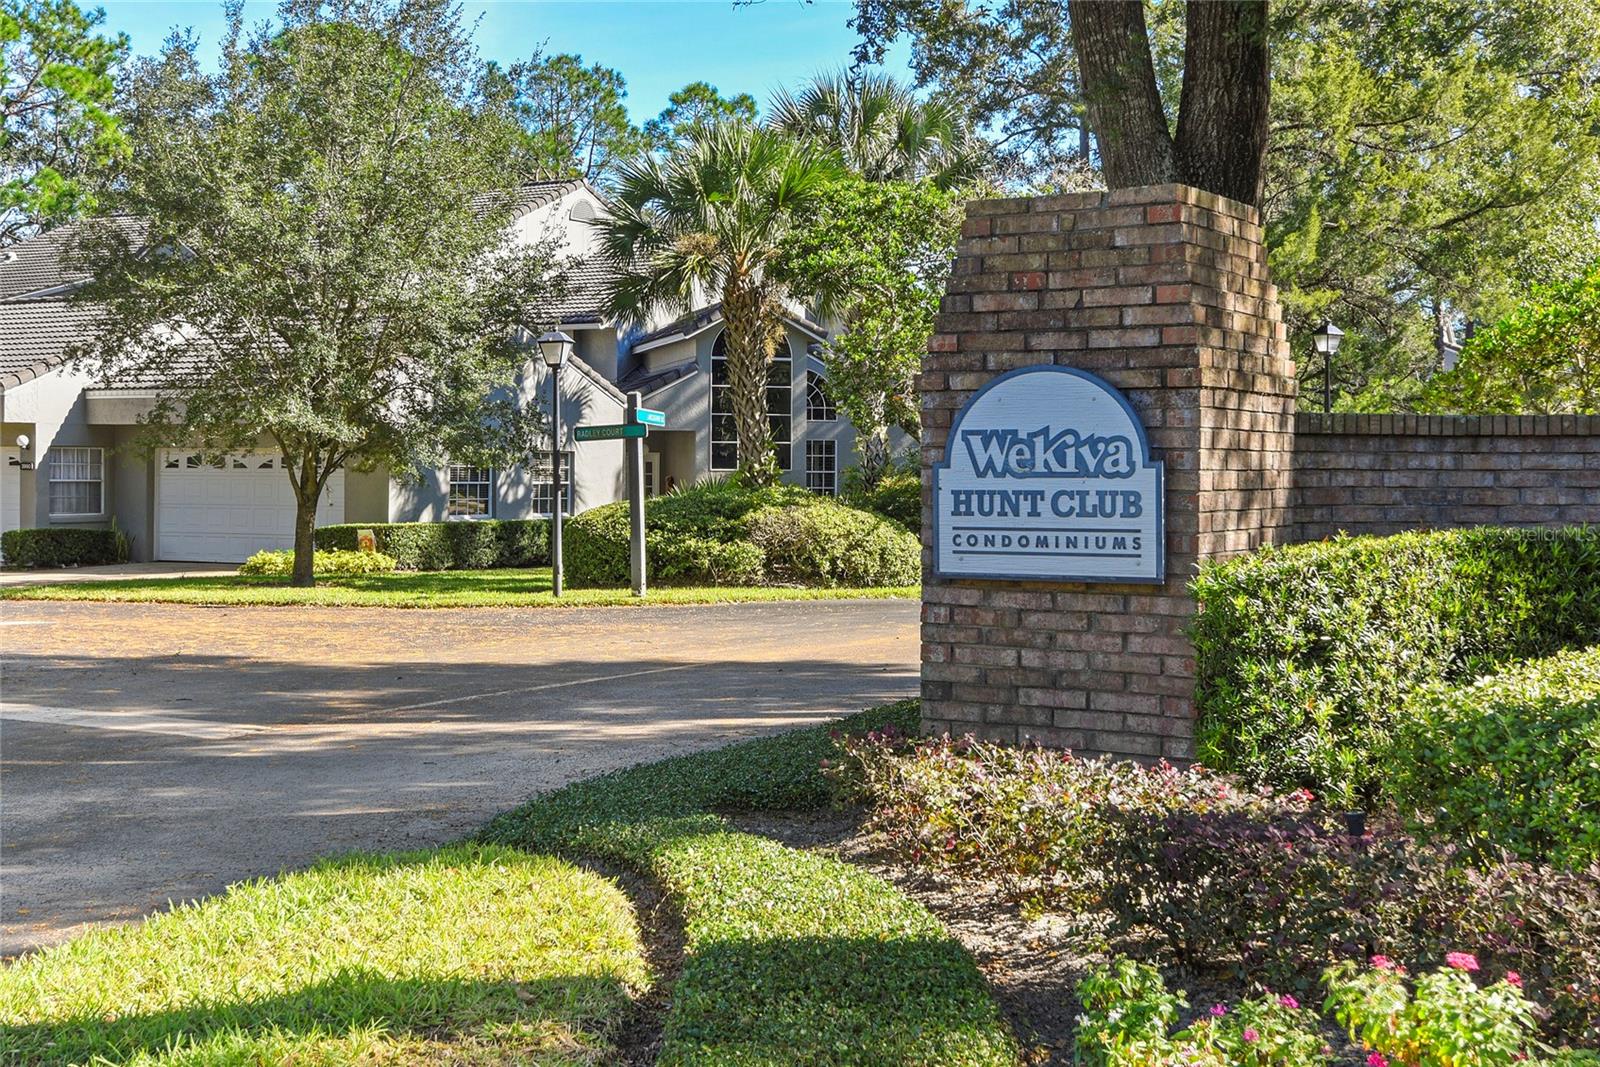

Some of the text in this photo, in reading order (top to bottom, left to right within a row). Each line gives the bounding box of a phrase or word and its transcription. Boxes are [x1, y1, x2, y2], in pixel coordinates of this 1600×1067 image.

[576, 427, 623, 438] RADLEY COURT
[951, 489, 1143, 518] HUNT CLUB
[952, 533, 1142, 550] CONDOMINIUMS
